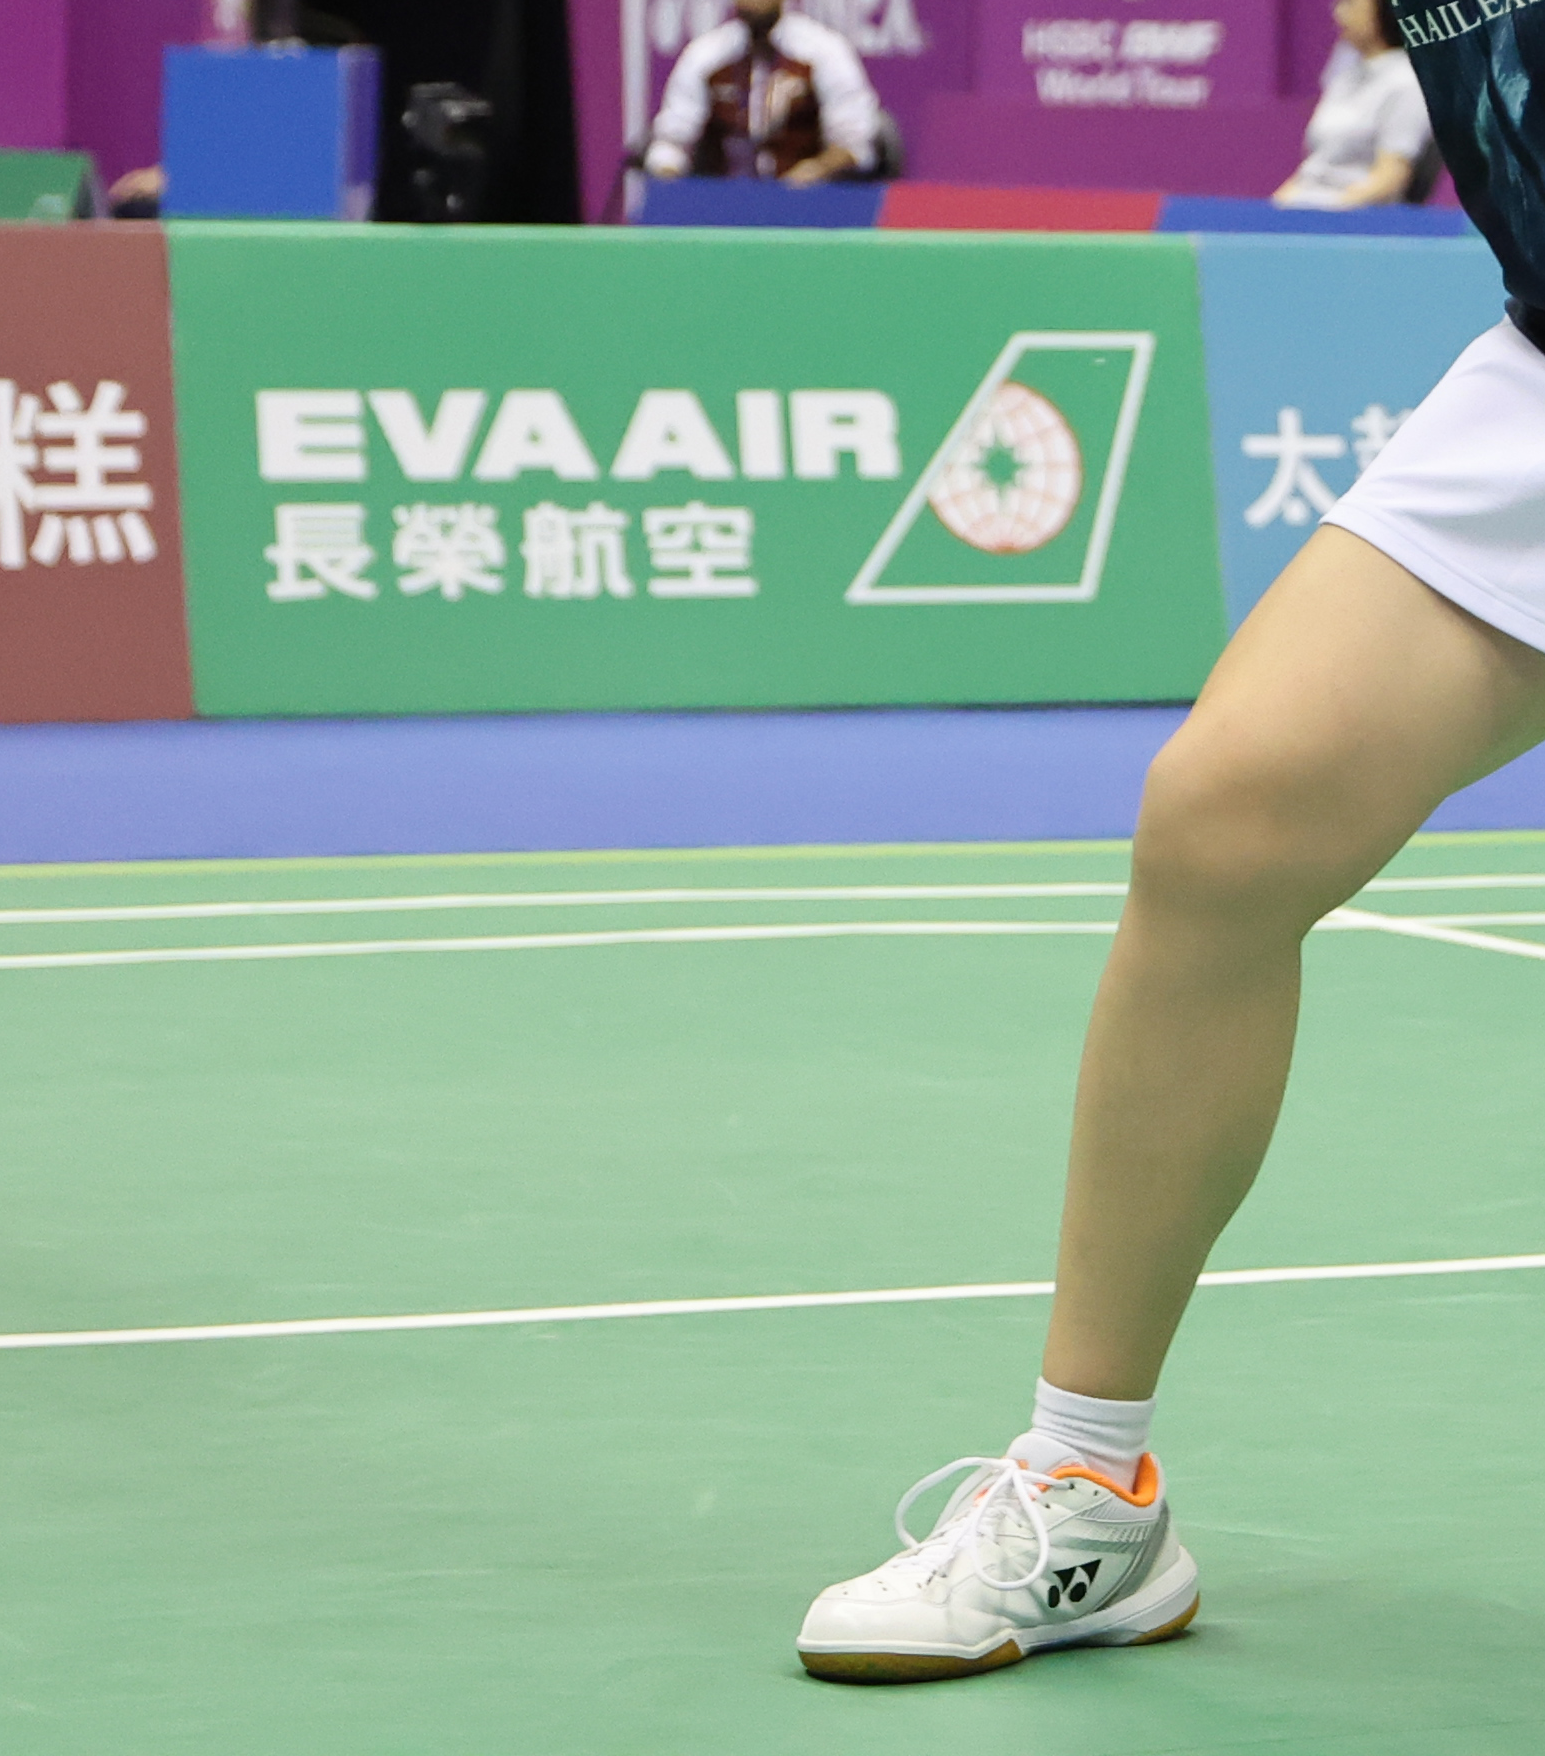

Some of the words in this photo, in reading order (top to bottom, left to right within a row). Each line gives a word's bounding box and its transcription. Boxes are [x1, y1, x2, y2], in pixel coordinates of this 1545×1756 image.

[254, 387, 601, 483] EVA
[609, 387, 901, 481] AIR
[263, 502, 760, 603] 長榮航空
